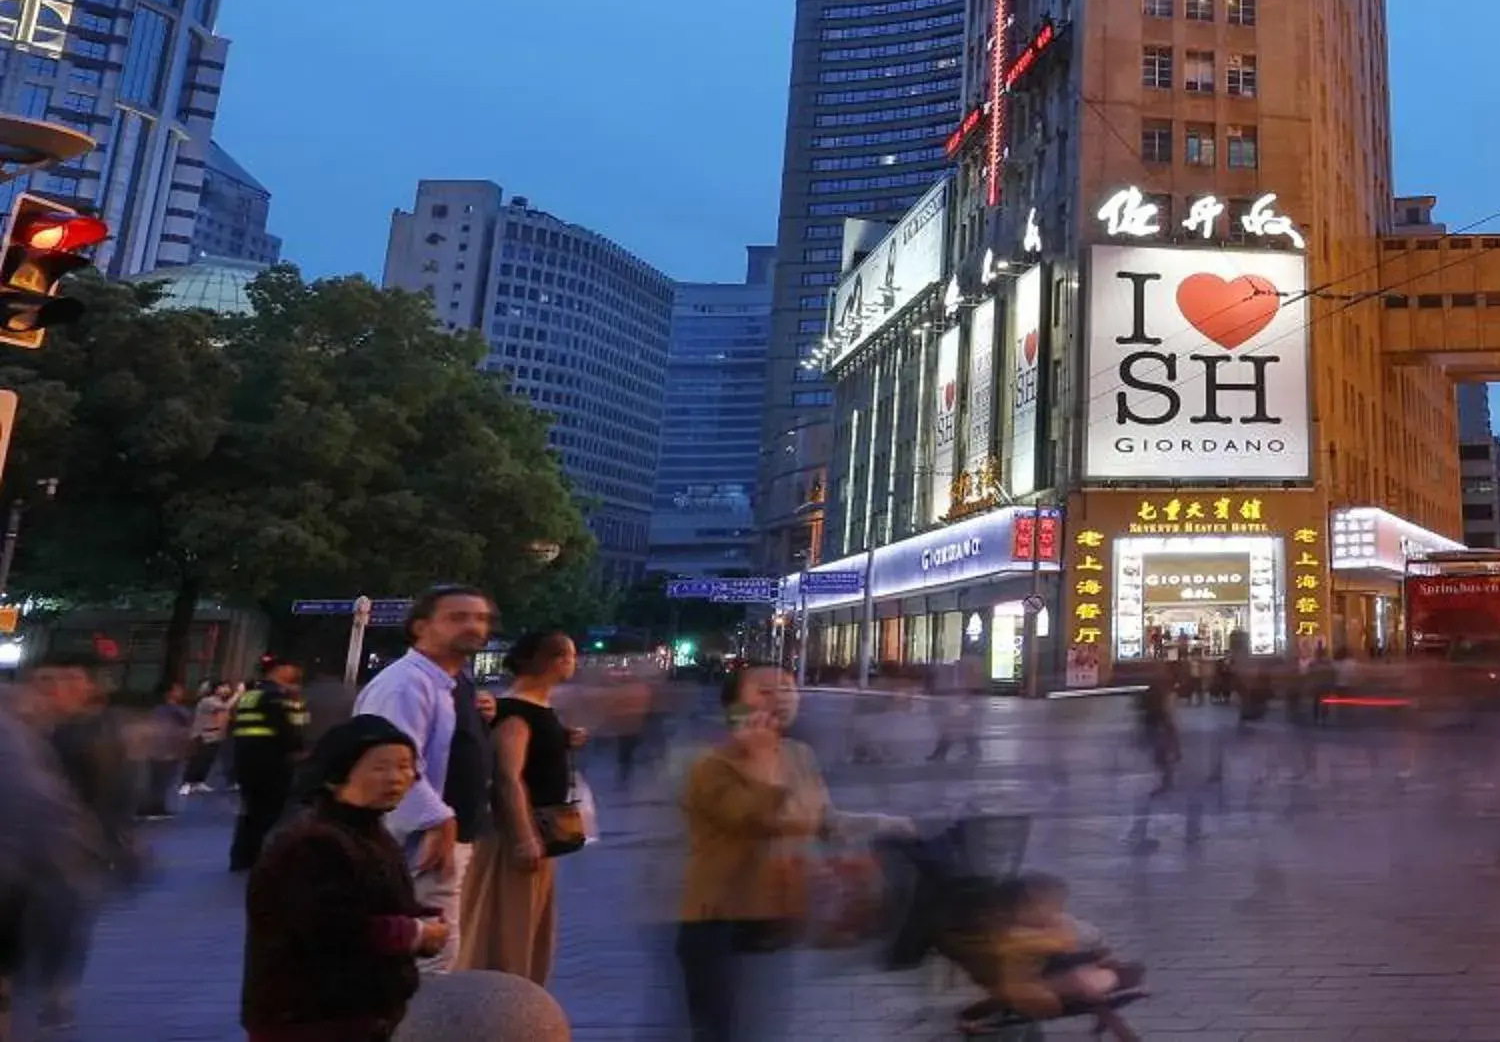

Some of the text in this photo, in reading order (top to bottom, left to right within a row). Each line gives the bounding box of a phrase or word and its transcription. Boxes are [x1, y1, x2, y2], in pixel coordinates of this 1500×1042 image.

[1115, 271, 1162, 345] I
[1116, 351, 1282, 426] SH
[1114, 437, 1286, 454] GIORDANO
[1144, 573, 1243, 586] GIORDANO
